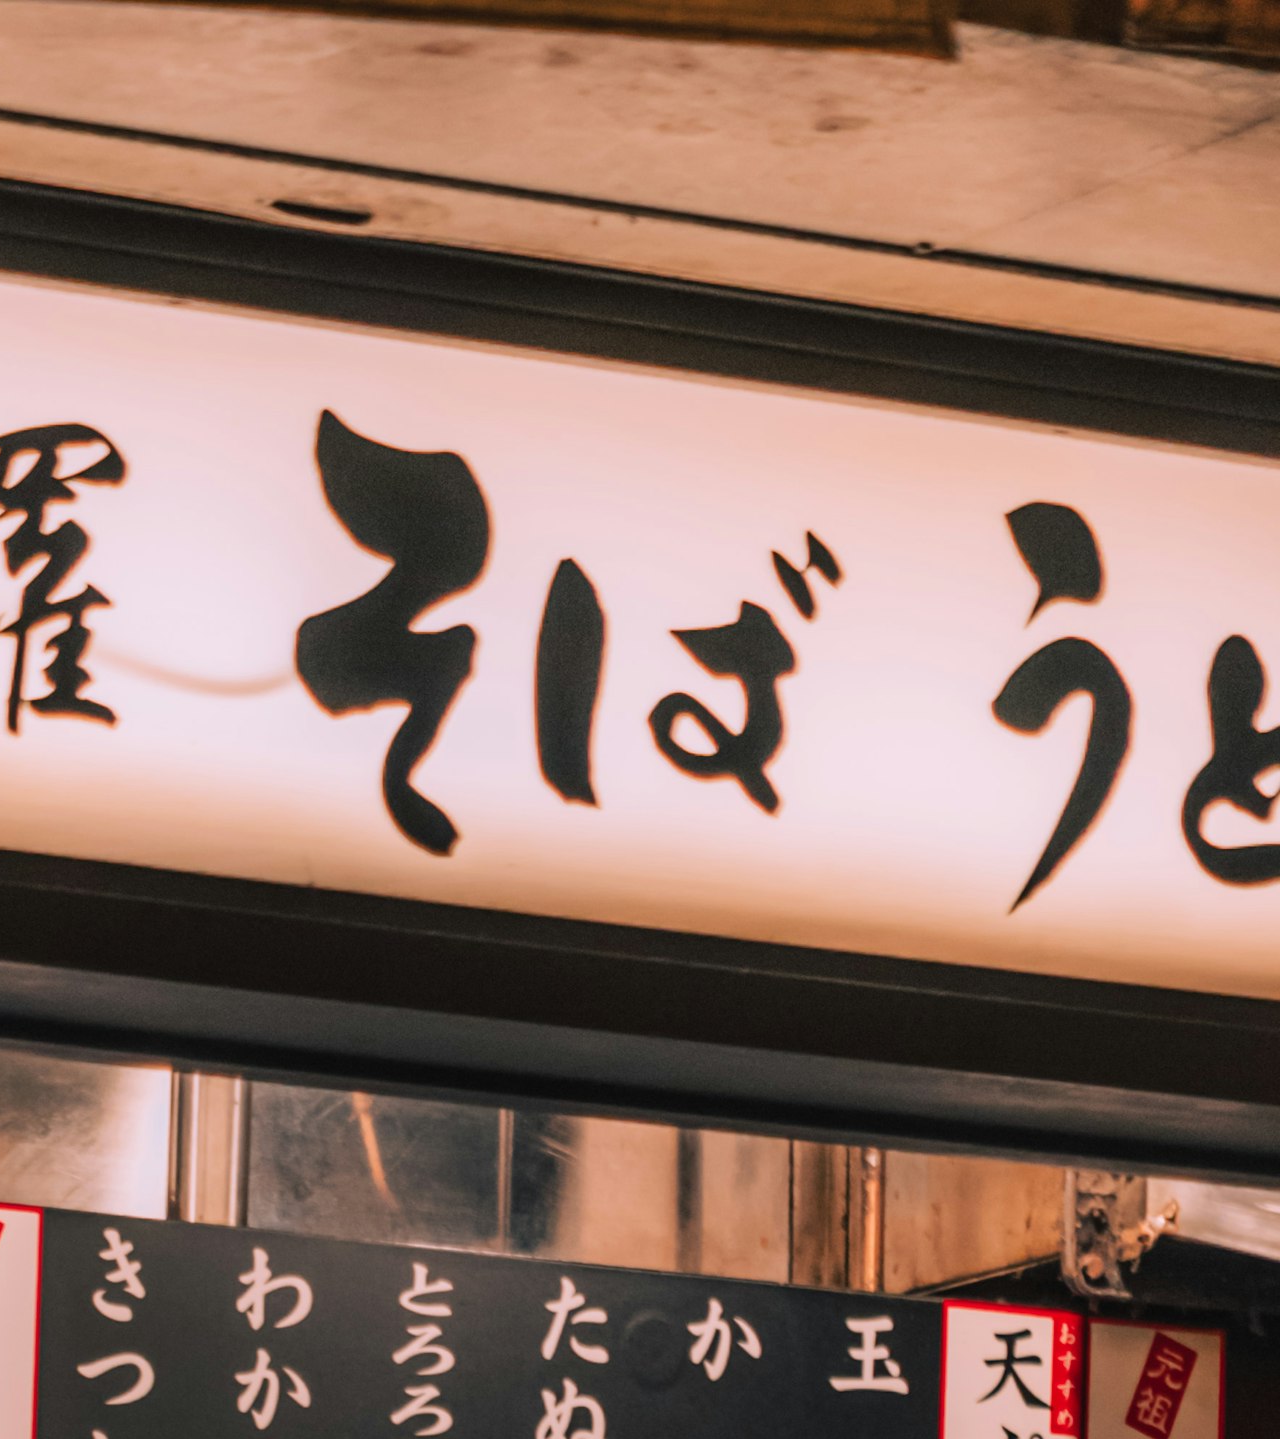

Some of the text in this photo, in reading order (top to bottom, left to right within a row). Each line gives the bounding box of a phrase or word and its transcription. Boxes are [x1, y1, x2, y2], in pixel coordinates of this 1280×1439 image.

[292, 405, 839, 858] そば
[1058, 1322, 1076, 1430] おすすめ
[1134, 1345, 1185, 1436] 元祖
